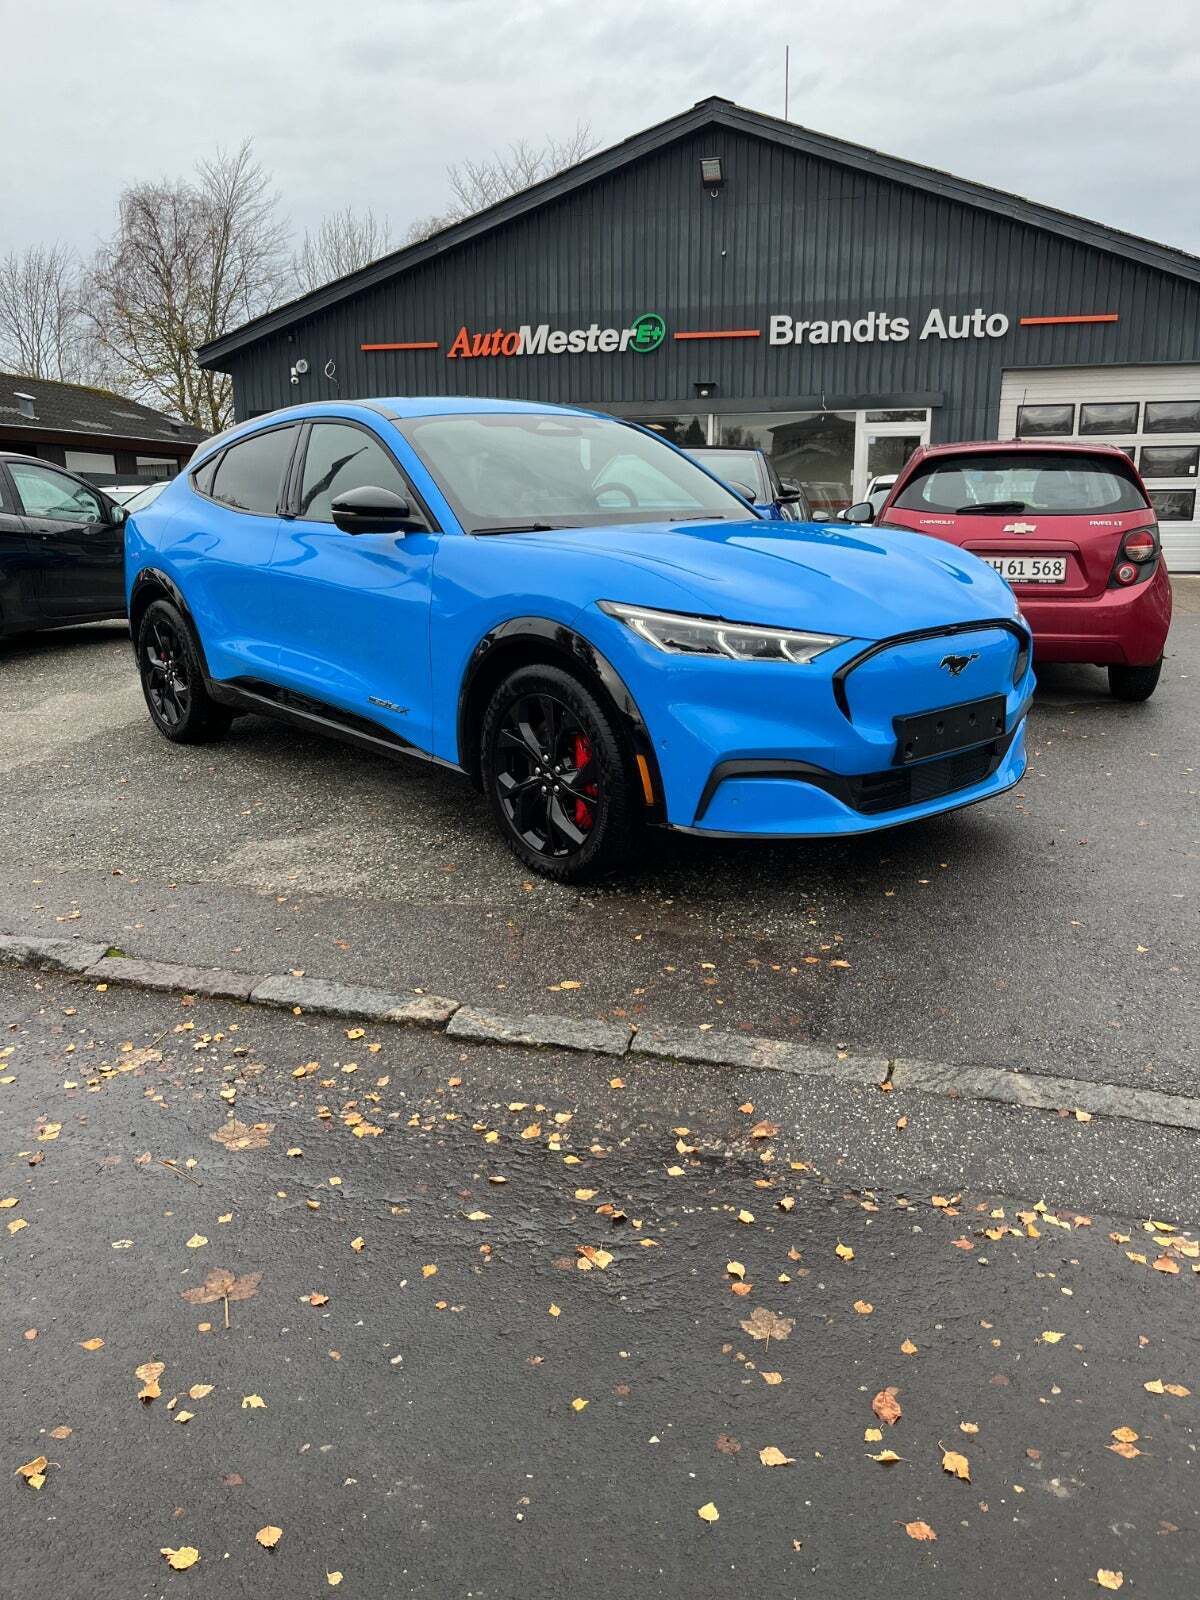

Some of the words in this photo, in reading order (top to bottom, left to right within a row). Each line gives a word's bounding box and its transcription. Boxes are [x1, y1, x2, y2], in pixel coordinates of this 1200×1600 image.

[447, 324, 637, 358] AutoMester
[769, 311, 910, 345] Brandts
[919, 308, 1009, 340] Auto
[1007, 560, 1025, 576] 61
[1032, 560, 1062, 576] 568
